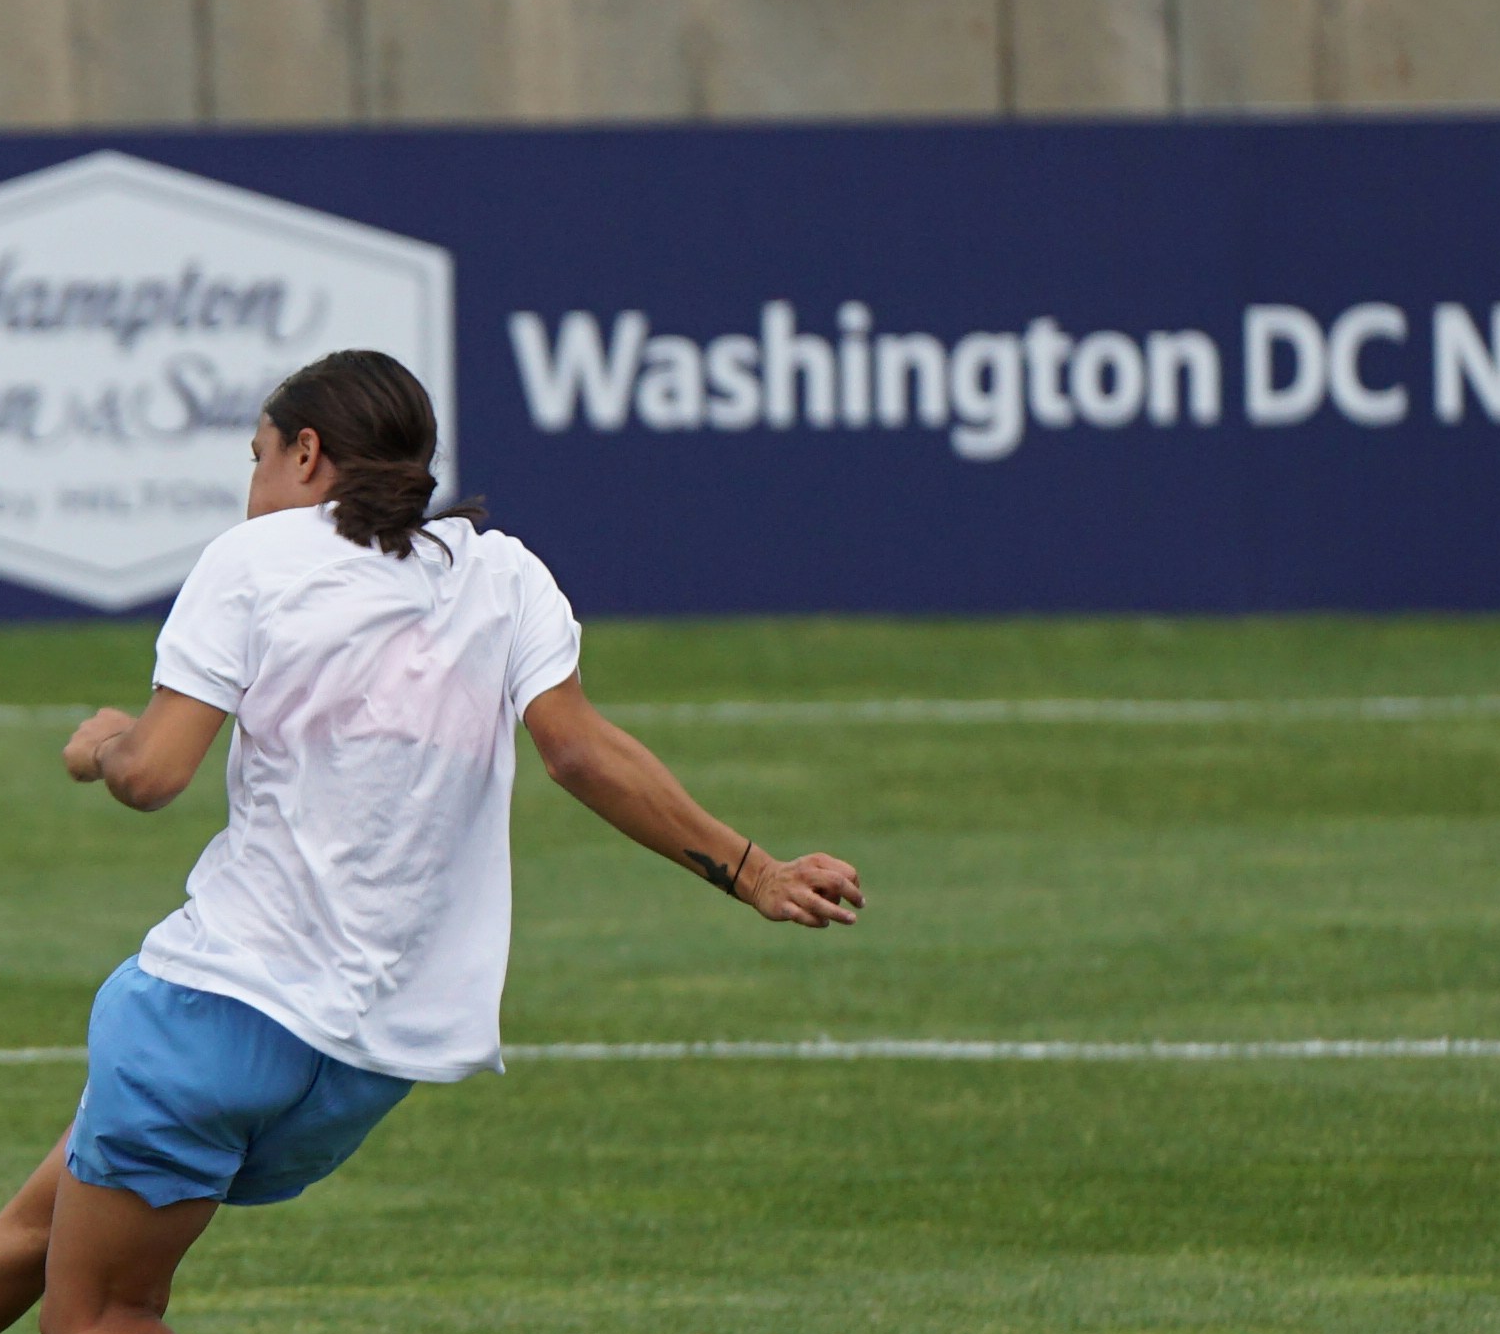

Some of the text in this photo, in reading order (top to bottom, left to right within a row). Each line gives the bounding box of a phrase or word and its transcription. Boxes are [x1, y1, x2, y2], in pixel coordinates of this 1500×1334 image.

[508, 299, 1222, 460] Washington
[1243, 302, 1408, 425] DC
[56, 477, 240, 515] HILTON
